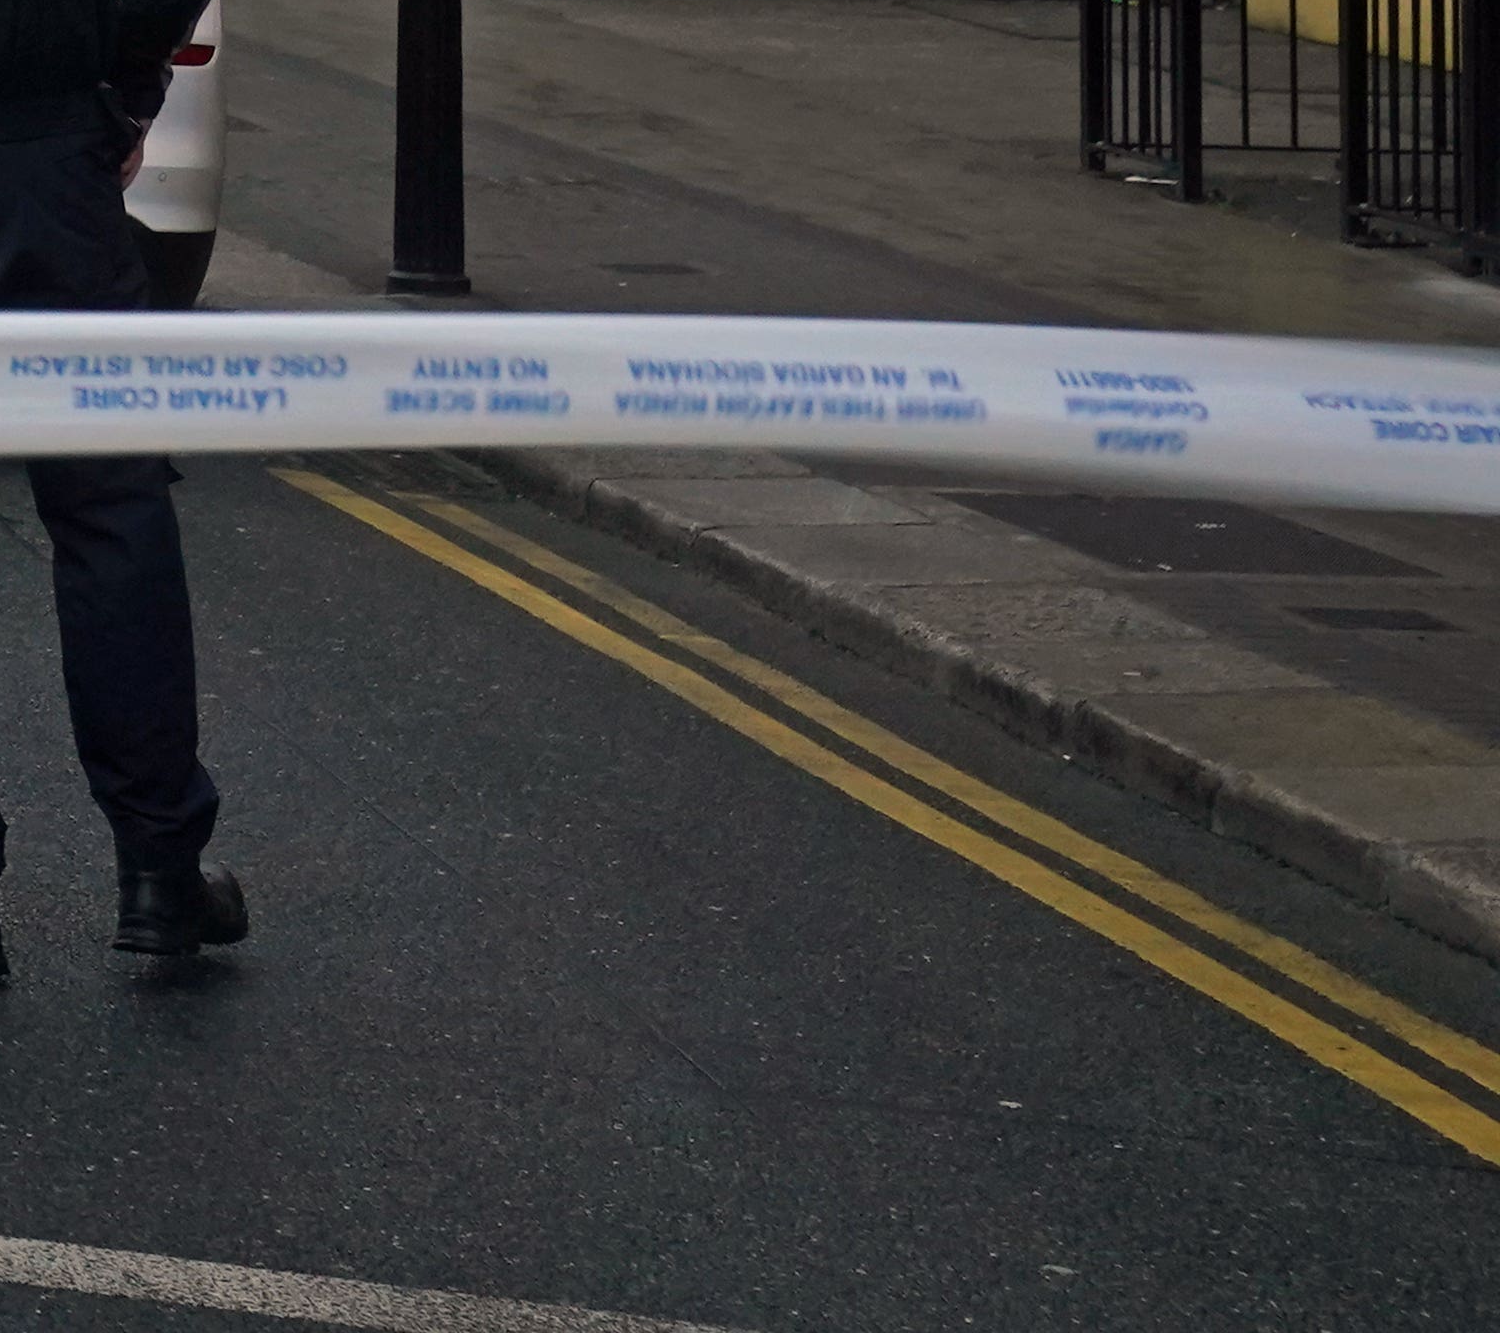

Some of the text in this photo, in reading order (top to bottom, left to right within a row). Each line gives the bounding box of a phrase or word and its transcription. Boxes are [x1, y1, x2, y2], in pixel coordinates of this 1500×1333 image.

[9, 354, 349, 379] COSC AR DHUL ISTEACH
[412, 356, 549, 380] NO ENTRY
[770, 361, 866, 386] GARDA
[870, 364, 907, 389] AN
[73, 386, 288, 414] LÁTHAIR COIRE
